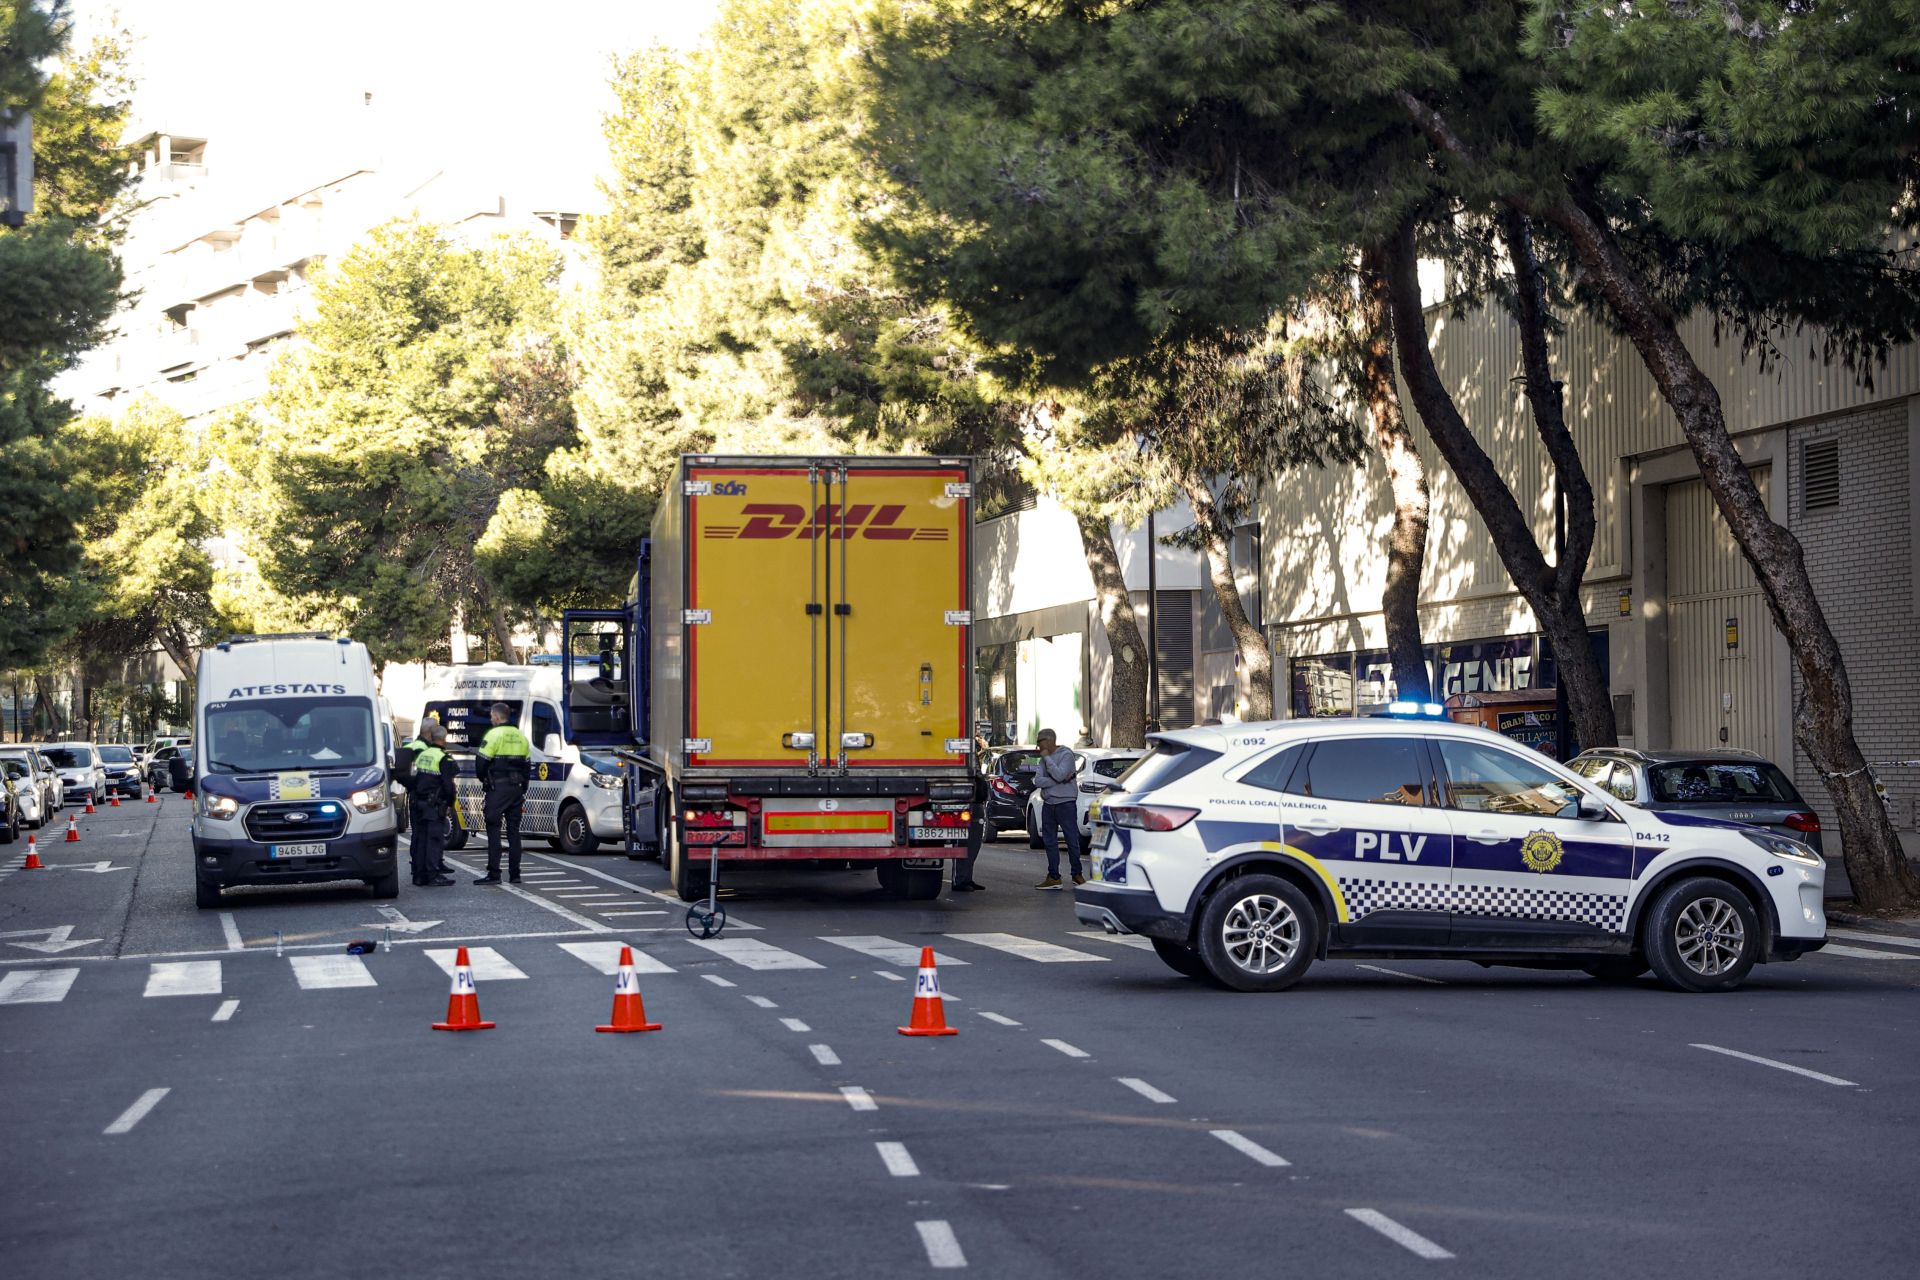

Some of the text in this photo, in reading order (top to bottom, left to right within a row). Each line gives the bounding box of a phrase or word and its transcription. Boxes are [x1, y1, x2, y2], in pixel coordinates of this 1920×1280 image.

[738, 504, 916, 540] DHL
[229, 684, 346, 699] ATESTATS
[448, 721, 466, 730] LOCAL
[1500, 716, 1525, 730] GRAN
[1243, 738, 1265, 746] 092
[825, 799, 832, 810] E
[1209, 798, 1246, 806] POLICIA
[1249, 800, 1280, 808] LOCAL
[917, 827, 967, 838] 3862 HHN
[1636, 832, 1670, 842] D4-12
[278, 844, 324, 856] 9465 LZG
[1355, 831, 1428, 861] PLV
[459, 971, 475, 989] PL
[919, 975, 939, 992] PLV
